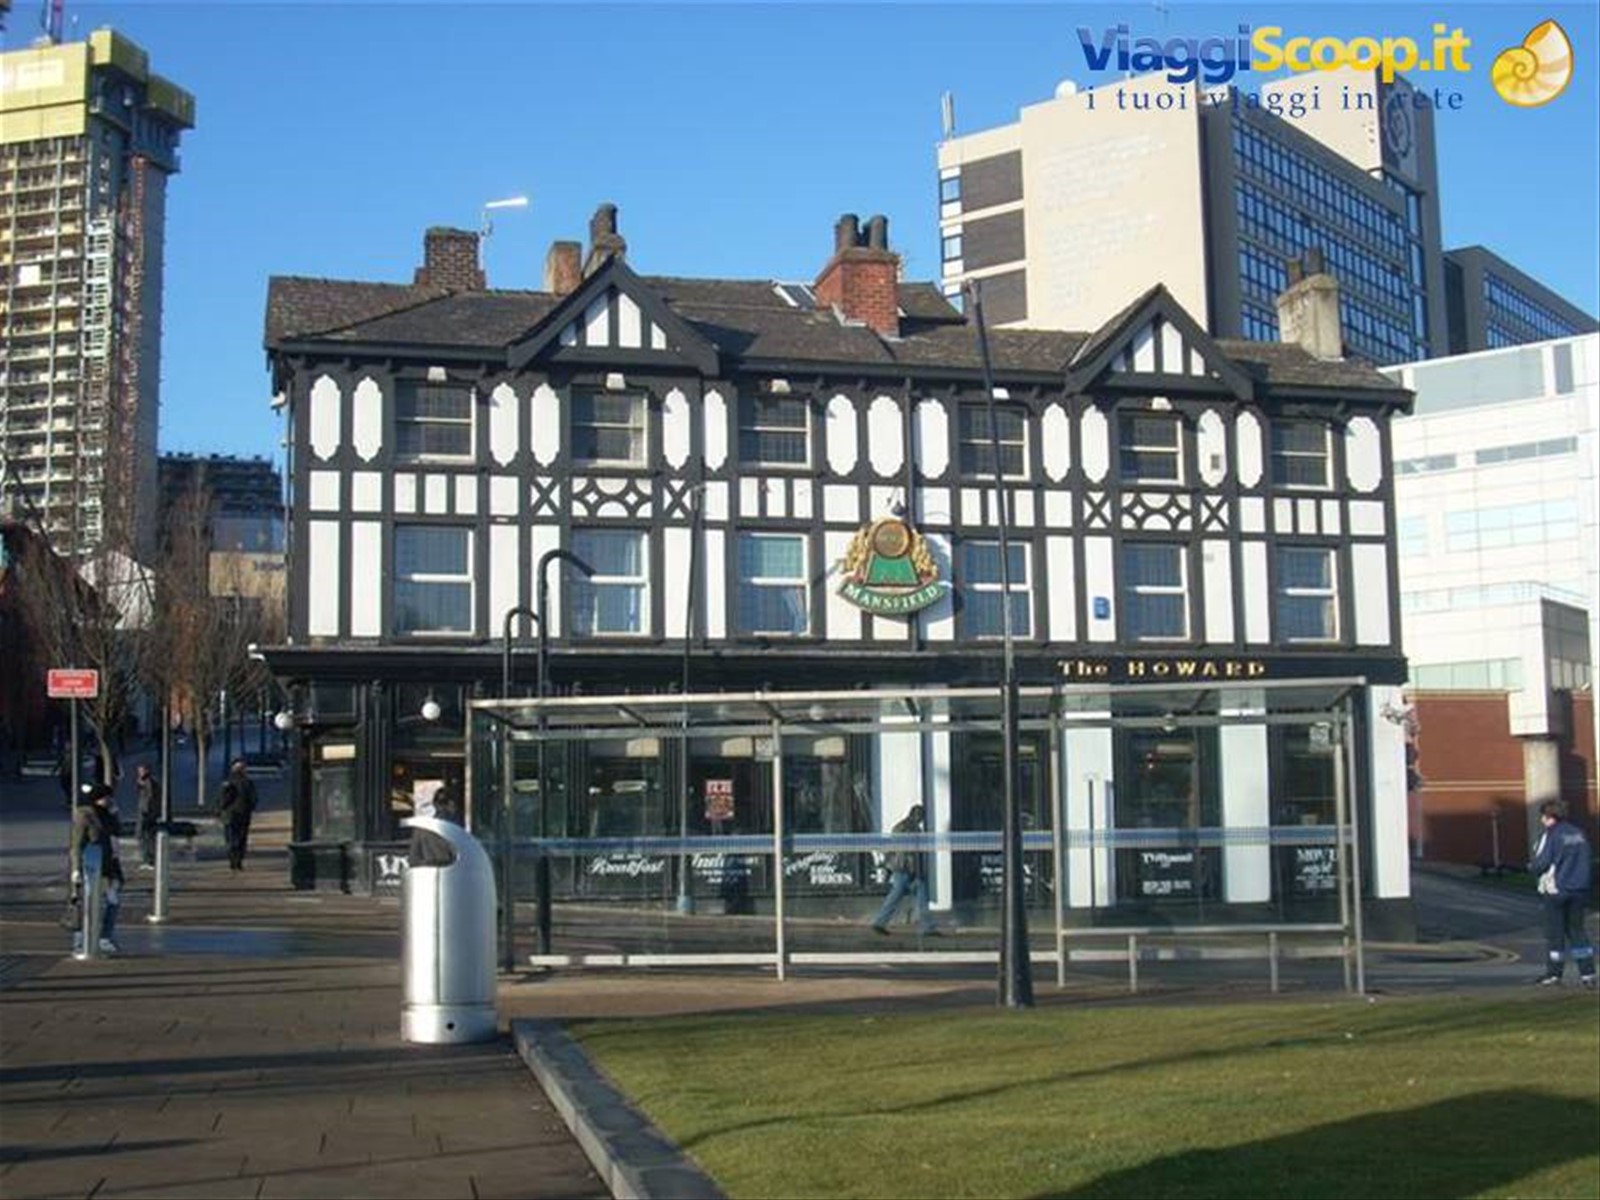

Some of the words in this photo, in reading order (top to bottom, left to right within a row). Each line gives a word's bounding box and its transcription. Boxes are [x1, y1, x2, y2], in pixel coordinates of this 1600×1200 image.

[844, 583, 939, 609] MANSFIELD
[1057, 660, 1108, 676] The
[1128, 660, 1265, 677] HOWARD
